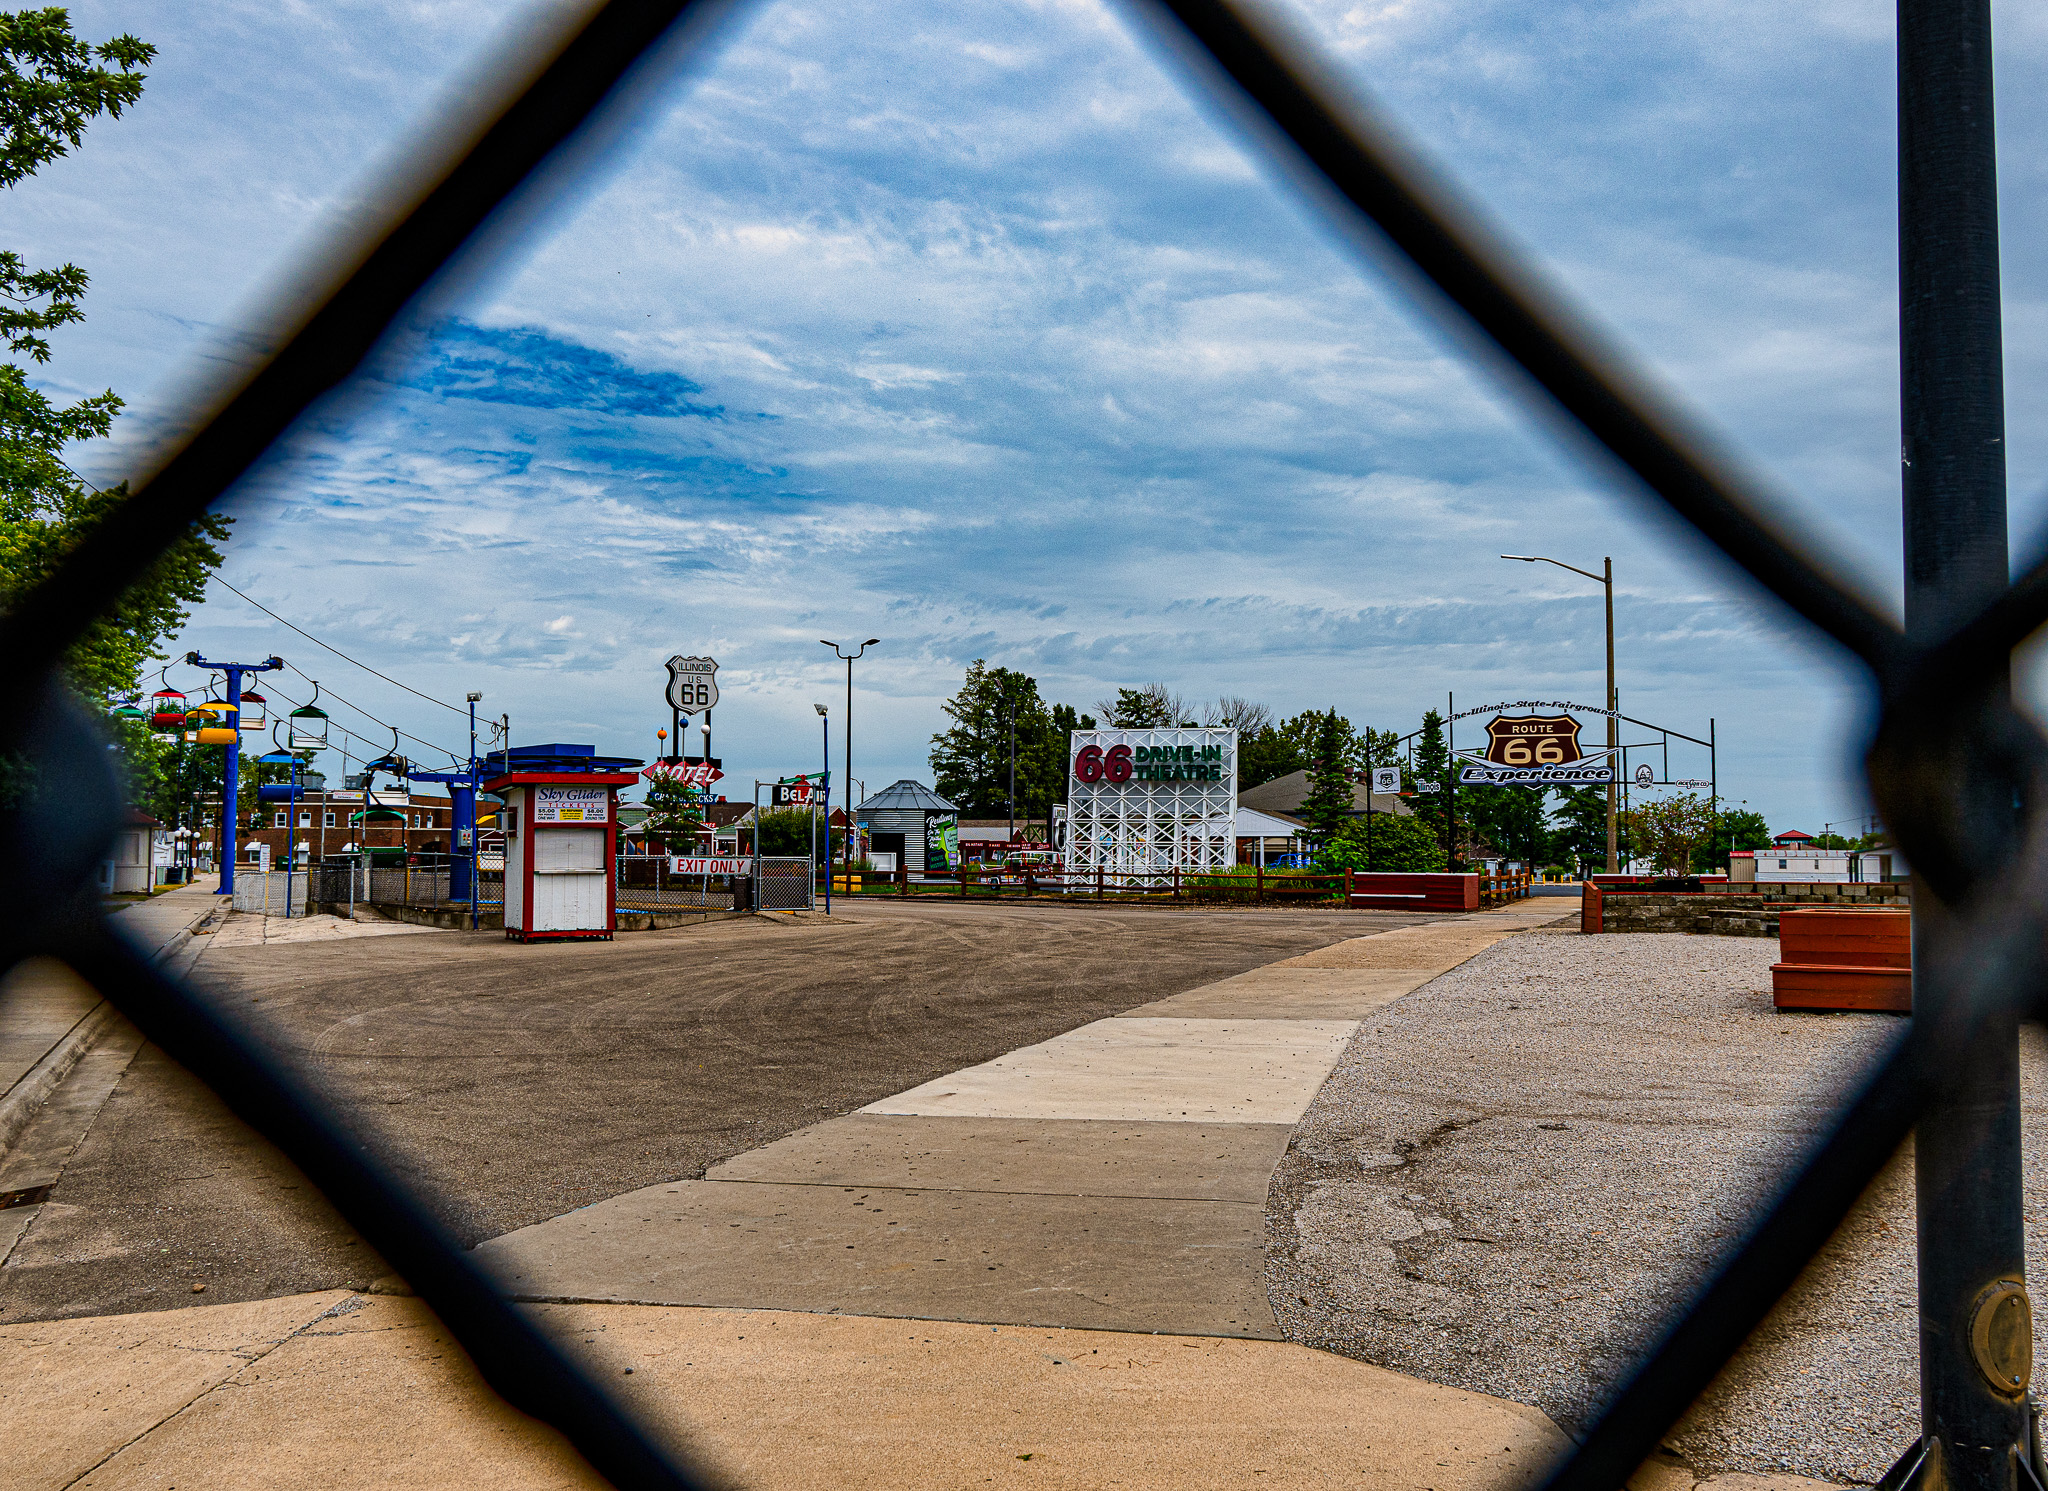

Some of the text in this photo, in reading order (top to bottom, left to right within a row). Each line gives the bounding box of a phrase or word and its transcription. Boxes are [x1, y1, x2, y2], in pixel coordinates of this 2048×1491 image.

[678, 662, 712, 672] ILLINOIS
[681, 684, 709, 706] 66
[1512, 724, 1554, 734] ROUTE
[1504, 738, 1564, 764] 66
[1075, 744, 1222, 783] 66 DRIVE-IN
[1134, 764, 1222, 782] THEATRE
[1461, 764, 1612, 784] Experience
[538, 788, 605, 802] Sky Glider
[677, 858, 745, 873] EXIT ONLY
